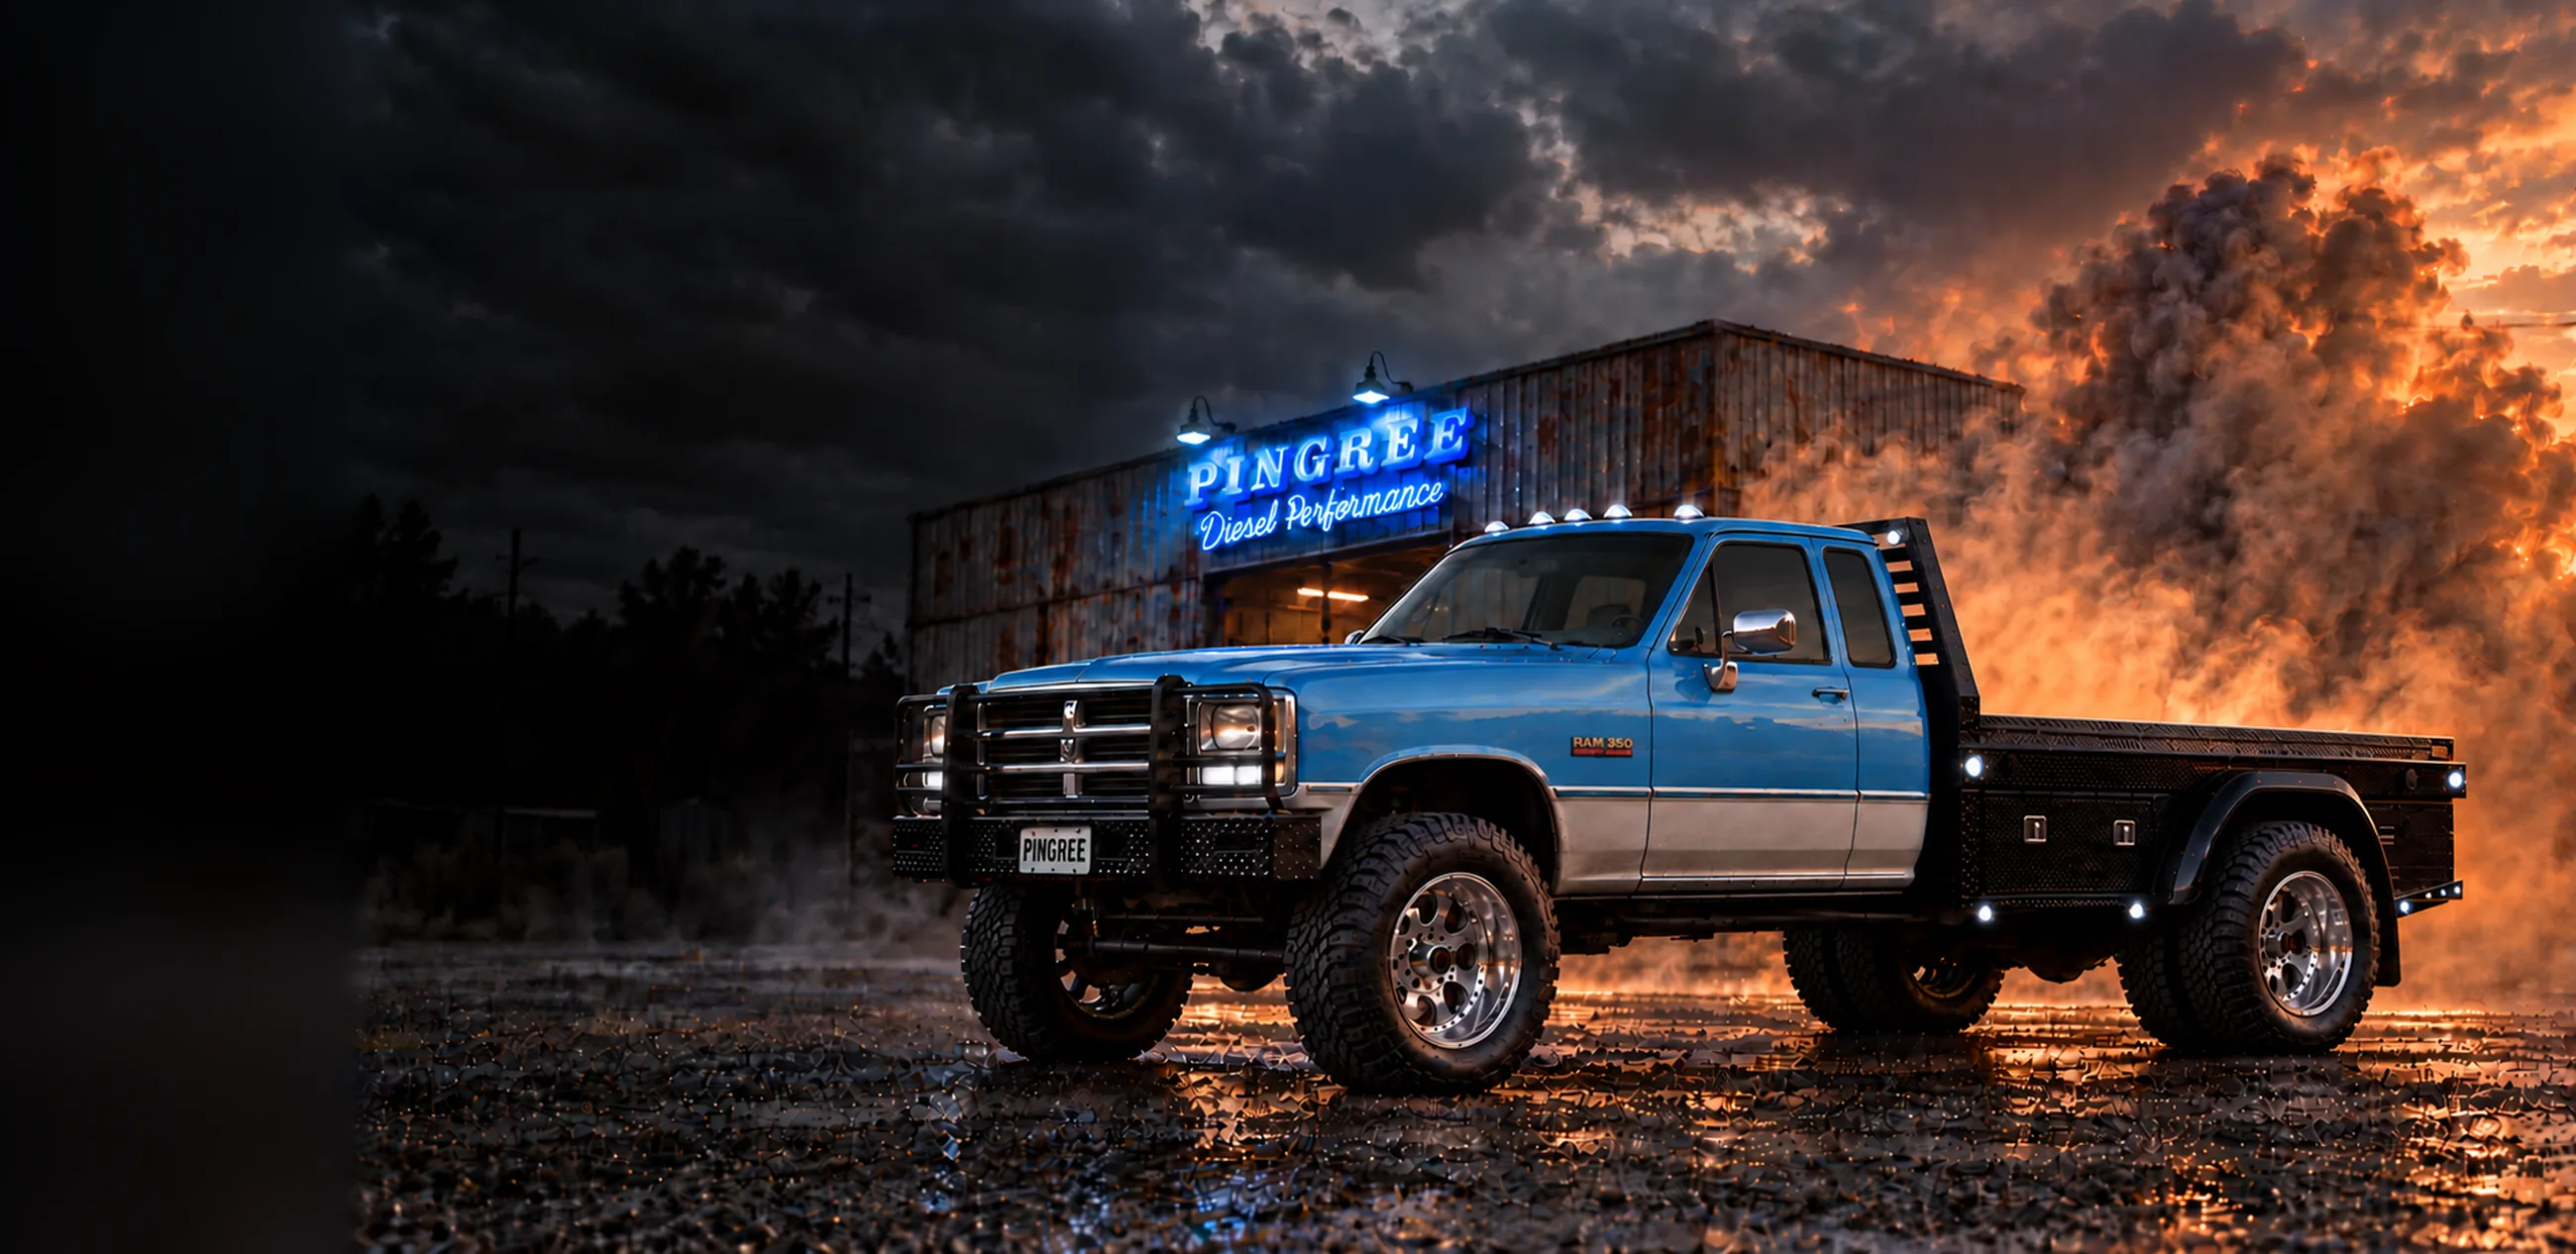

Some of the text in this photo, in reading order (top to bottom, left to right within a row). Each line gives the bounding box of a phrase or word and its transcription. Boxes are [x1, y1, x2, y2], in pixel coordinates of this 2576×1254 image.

[1184, 407, 1471, 507] PINGREE
[1201, 481, 1445, 551] Diesel Performance
[1572, 737, 1633, 749] RAM 350
[1022, 838, 1087, 863] PINGREE
